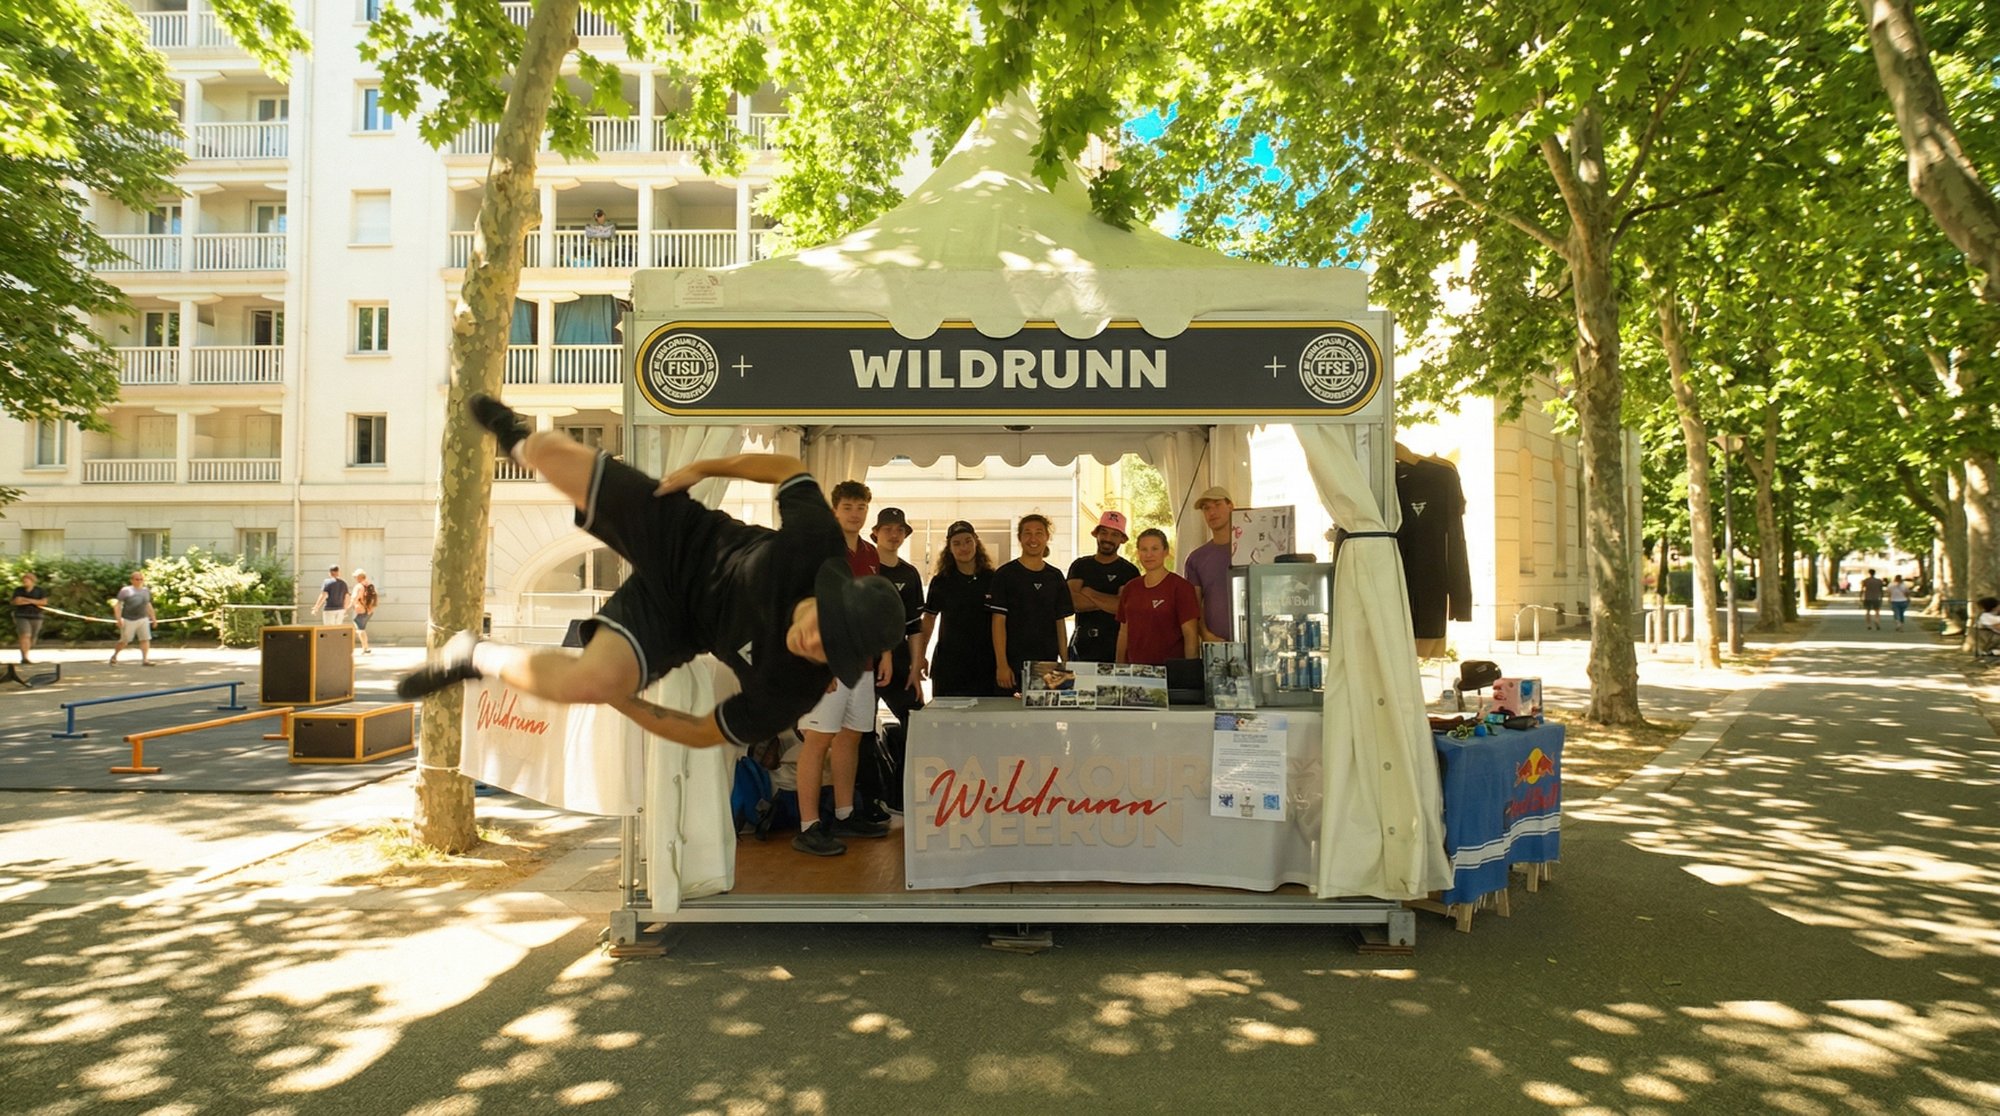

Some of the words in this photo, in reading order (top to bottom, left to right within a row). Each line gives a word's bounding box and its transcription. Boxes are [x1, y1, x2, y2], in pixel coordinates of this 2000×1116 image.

[668, 361, 700, 375] FISU
[849, 349, 1167, 389] WILDRUNN
[1317, 361, 1351, 375] FFSE
[914, 755, 1208, 804] PARKOUR
[929, 759, 1168, 827] Wildrunn
[915, 803, 1184, 852] FREERUN
